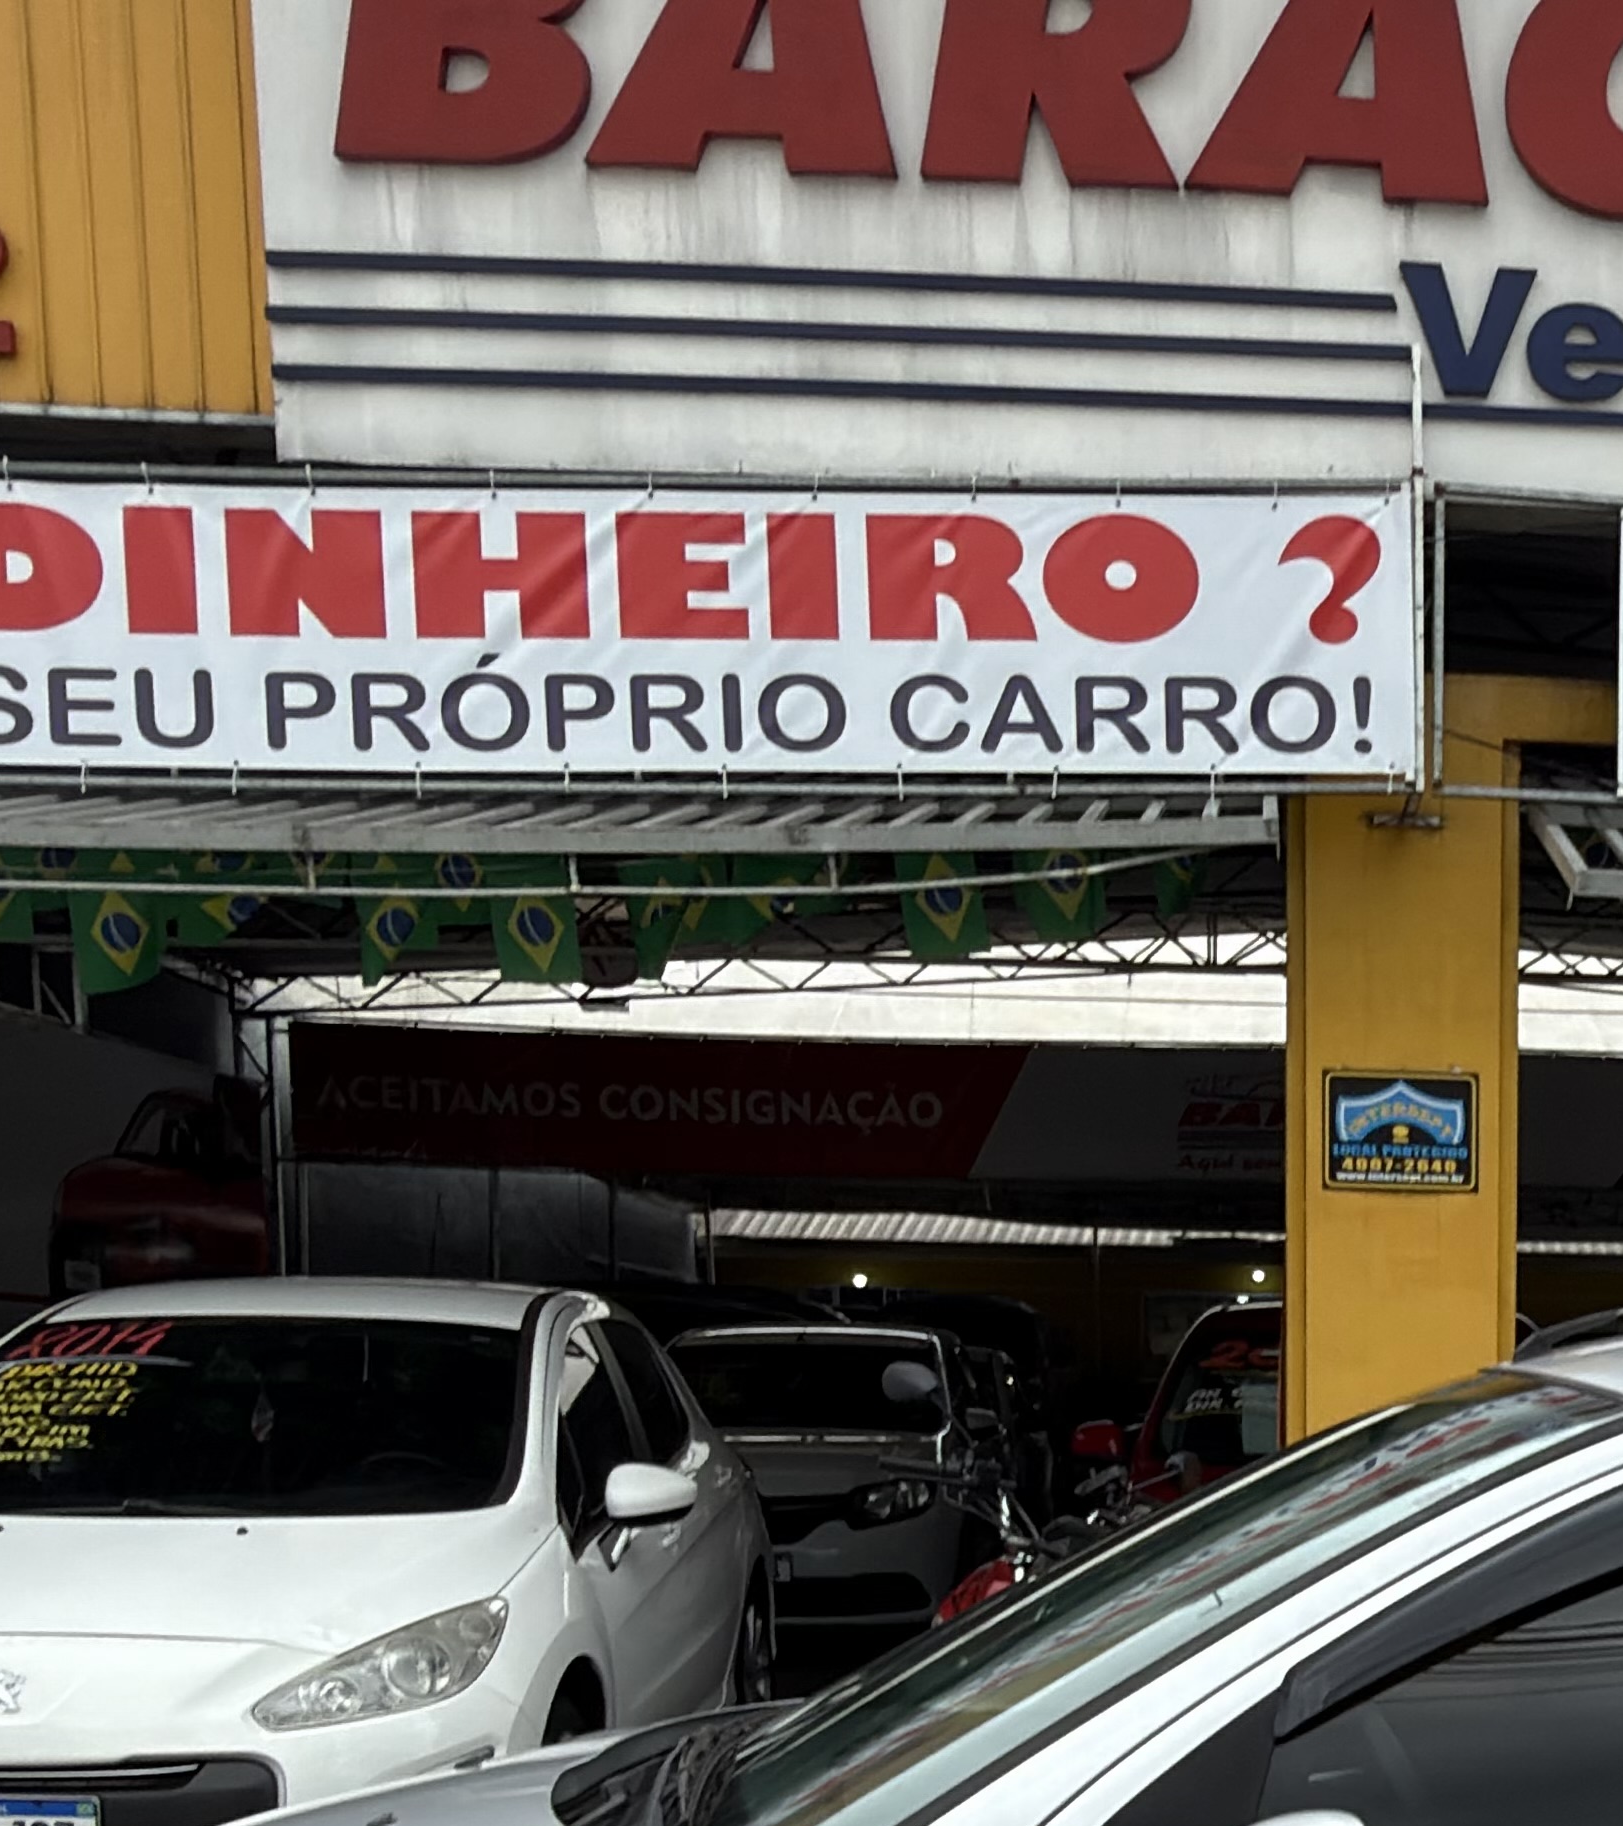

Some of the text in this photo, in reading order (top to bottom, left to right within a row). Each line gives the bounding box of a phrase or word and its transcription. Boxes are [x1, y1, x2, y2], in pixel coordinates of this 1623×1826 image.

[1279, 514, 1382, 646] ?
[265, 652, 848, 754] PRÓPRIO
[889, 673, 1373, 756] CARRO!
[314, 1073, 944, 1136] ACEITAMOS CONSIGNAÇÃO
